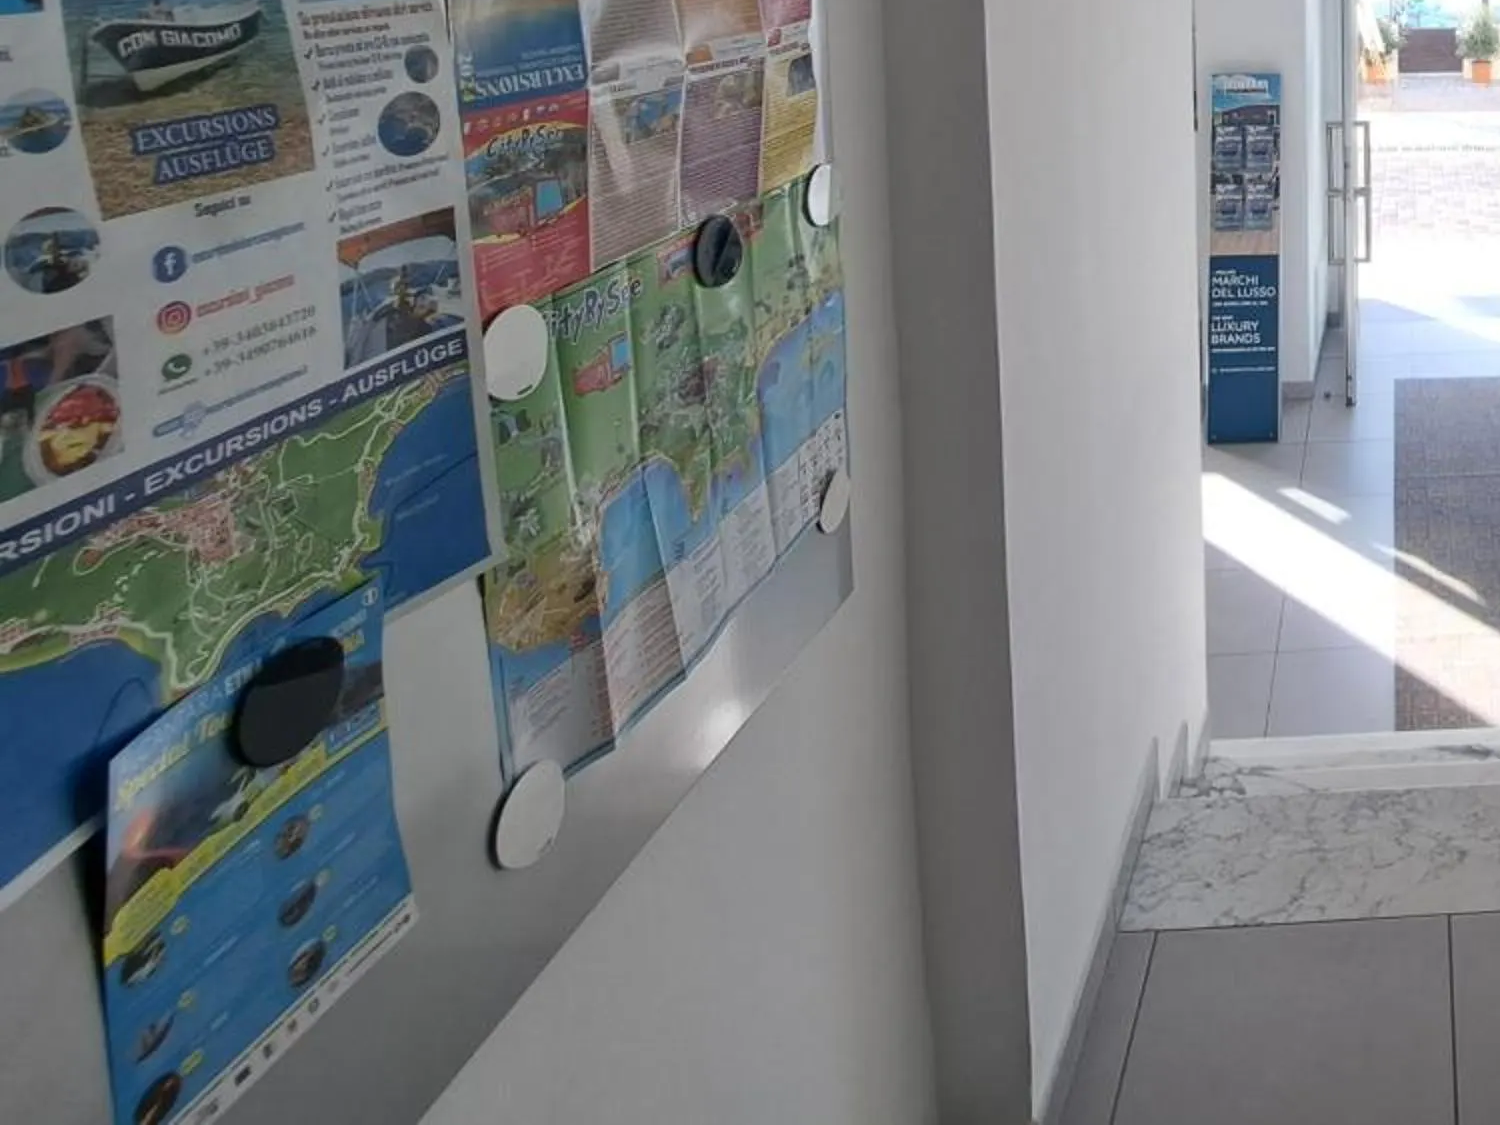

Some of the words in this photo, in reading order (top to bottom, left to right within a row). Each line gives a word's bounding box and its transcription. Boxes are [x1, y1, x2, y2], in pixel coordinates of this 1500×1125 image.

[117, 31, 158, 58] CON
[160, 21, 243, 49] GIACOMO
[135, 106, 276, 152] EXCURSIONS
[1211, 274, 1260, 286] MARCHI
[1211, 287, 1236, 298] DEL
[1237, 286, 1277, 298] LUSSO
[1211, 320, 1260, 332] LUXURY
[1211, 333, 1262, 345] BRANDS
[143, 397, 324, 496] EXCURSIONS
[341, 337, 465, 401] AUSFLÜGE
